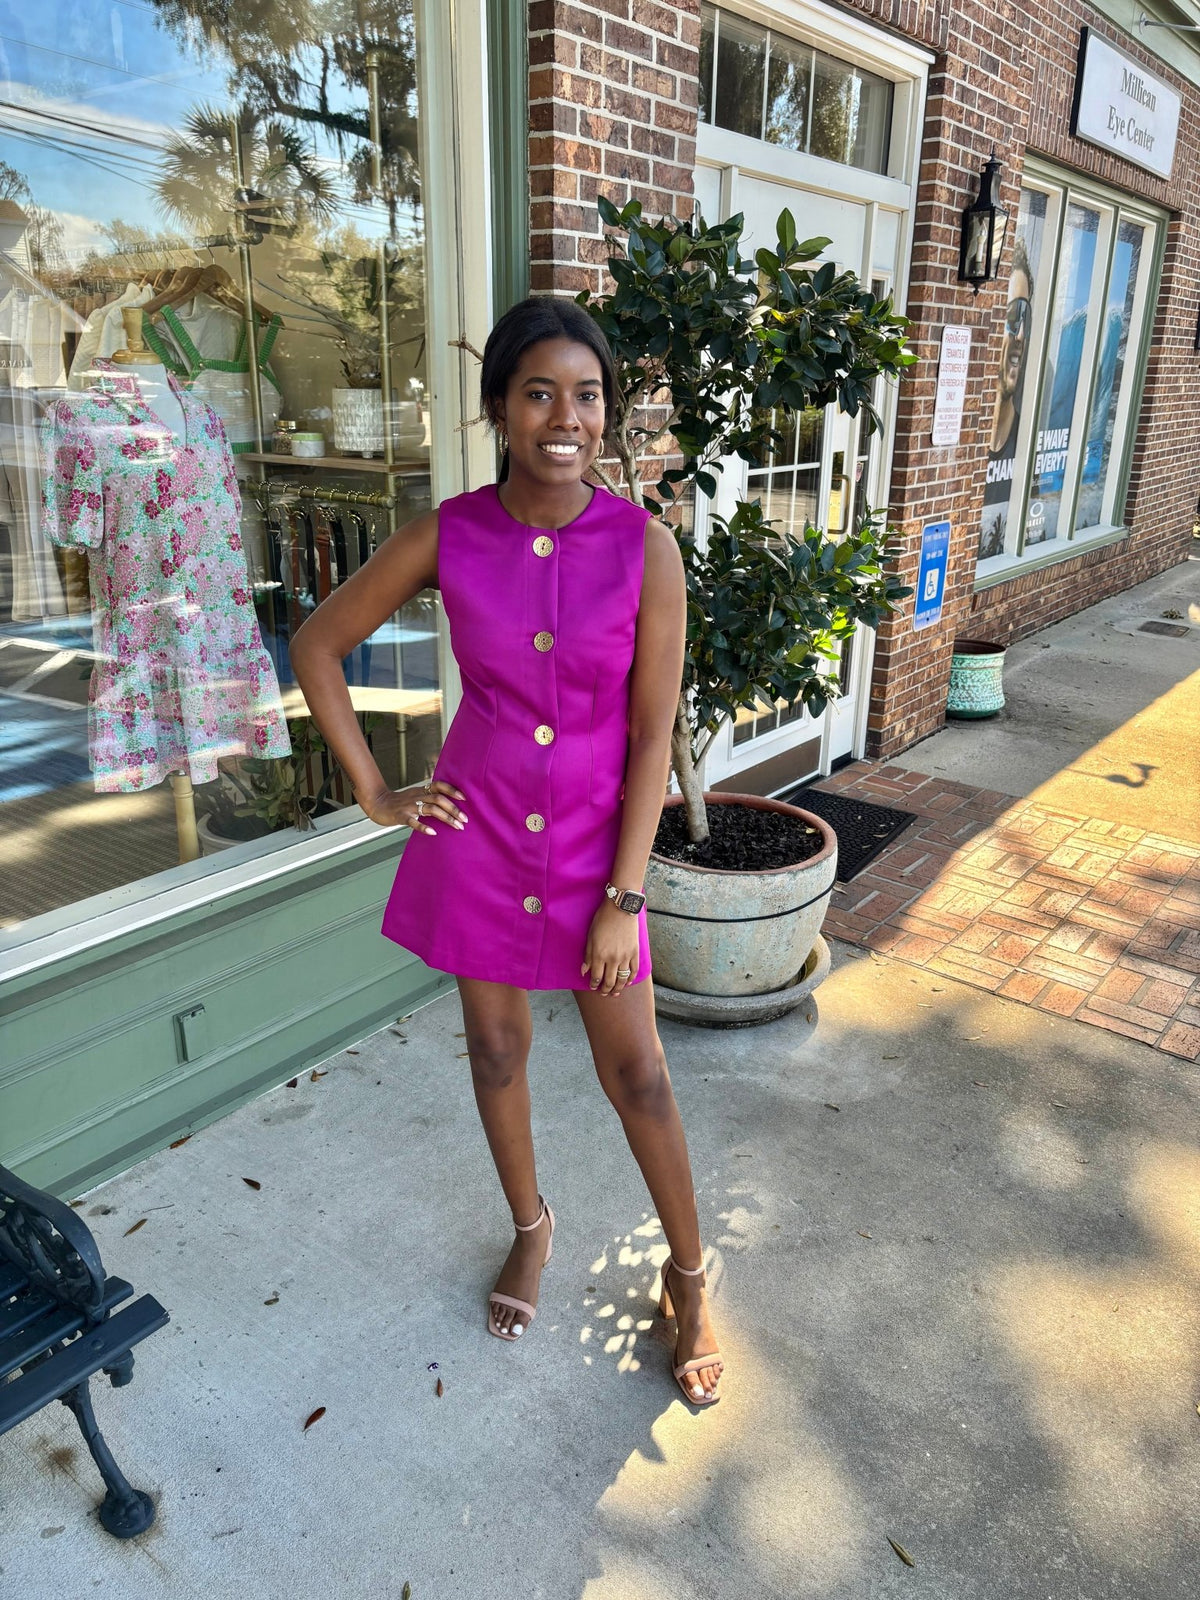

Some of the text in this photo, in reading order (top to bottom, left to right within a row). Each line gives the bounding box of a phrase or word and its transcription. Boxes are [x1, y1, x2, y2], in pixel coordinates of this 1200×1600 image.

[1120, 67, 1157, 112] Millican
[1107, 105, 1155, 152] Eye Center
[1044, 428, 1070, 450] WAVE
[986, 457, 1016, 484] CHAN
